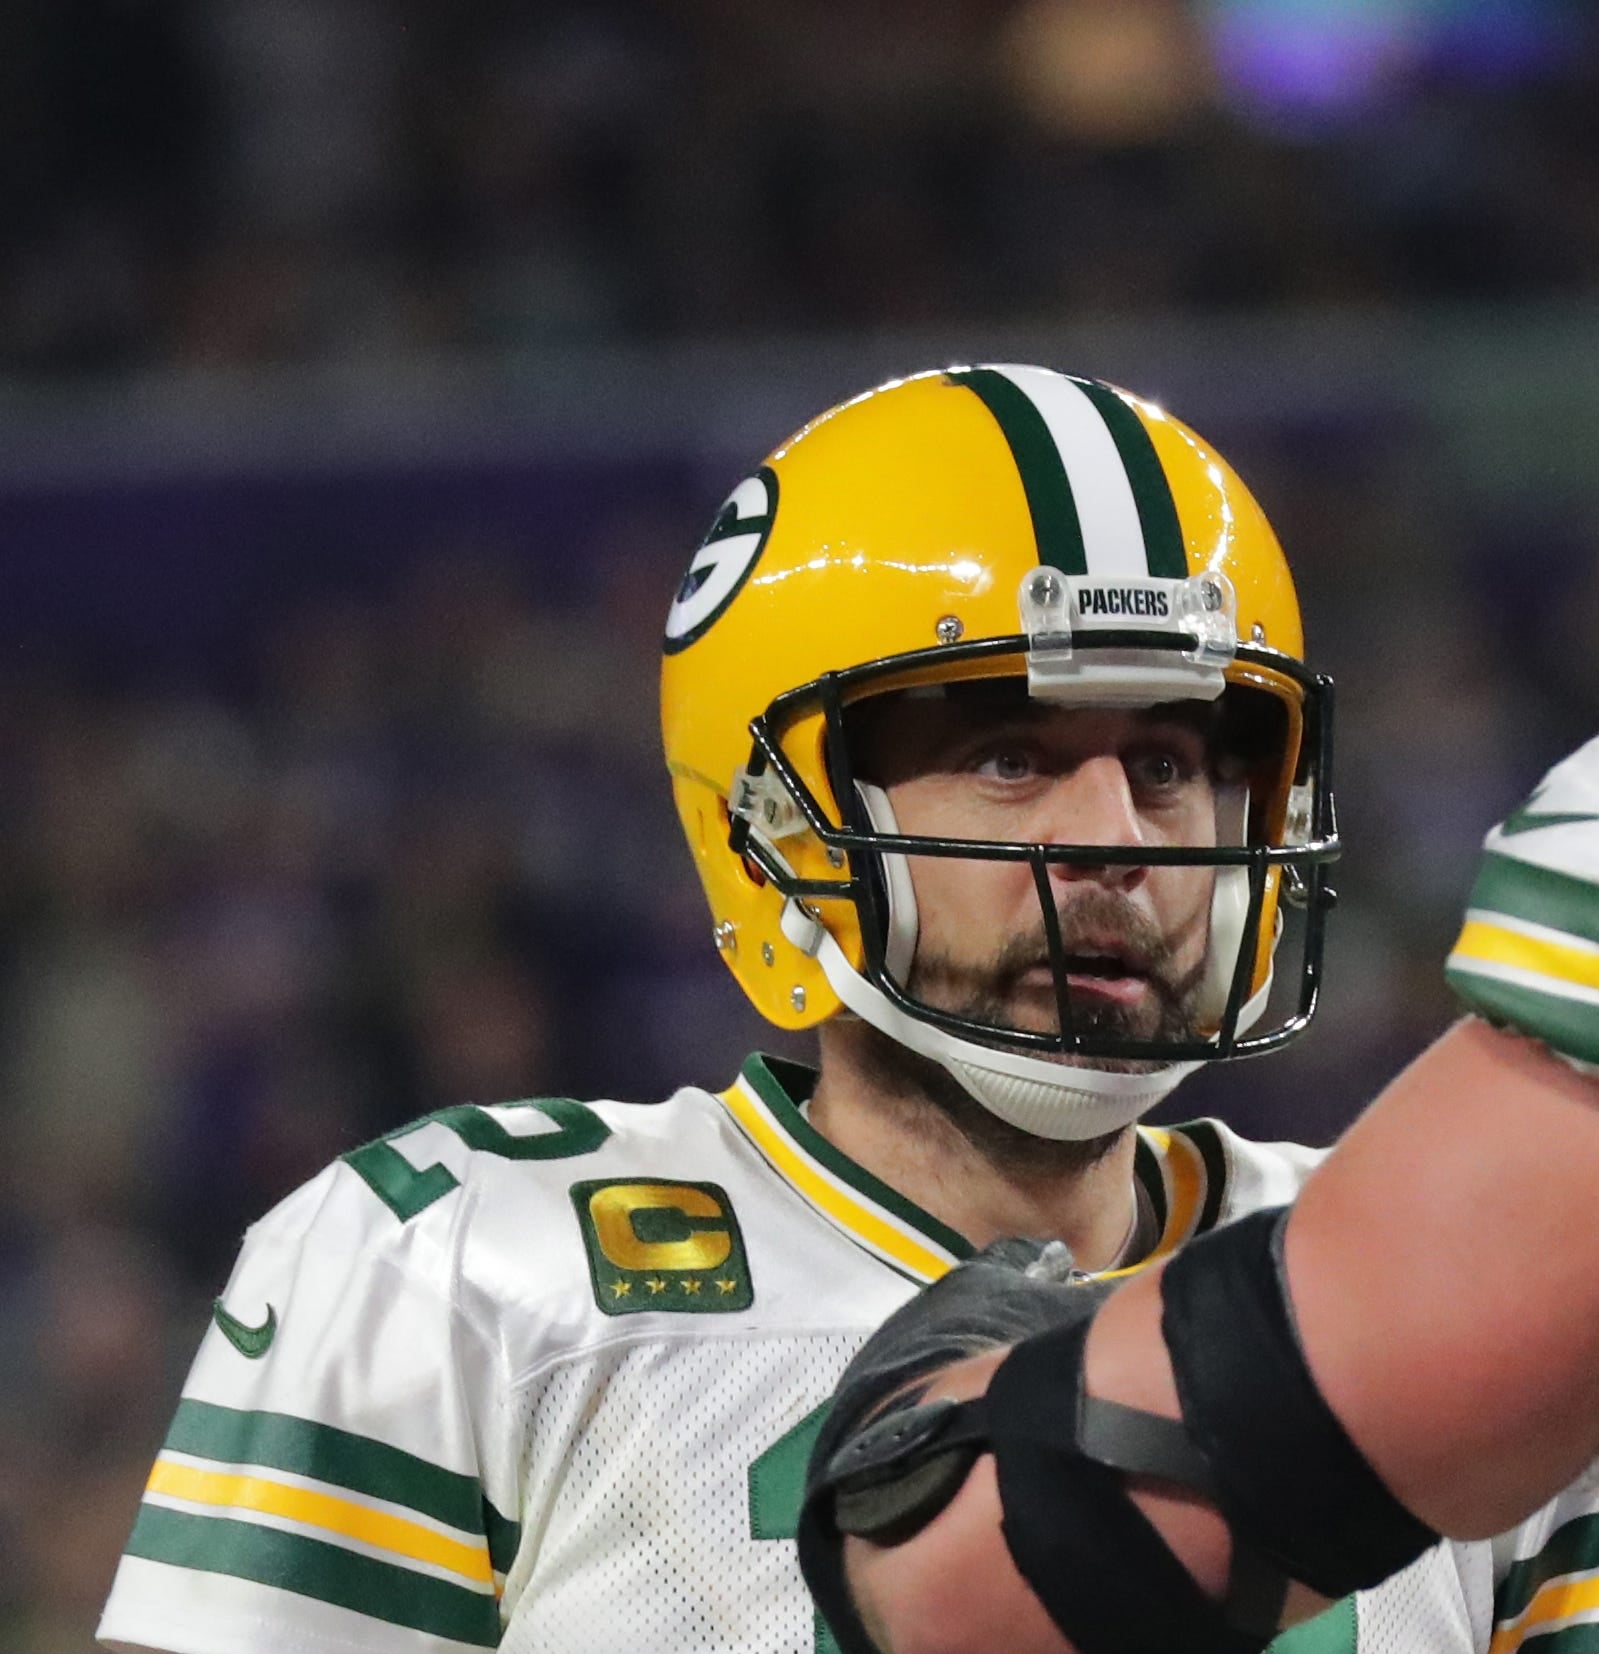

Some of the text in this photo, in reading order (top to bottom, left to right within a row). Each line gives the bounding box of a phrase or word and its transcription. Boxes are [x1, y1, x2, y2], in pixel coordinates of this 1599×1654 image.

[664, 473, 772, 643] G
[1079, 588, 1169, 617] PACKERS
[589, 1184, 732, 1271] C
